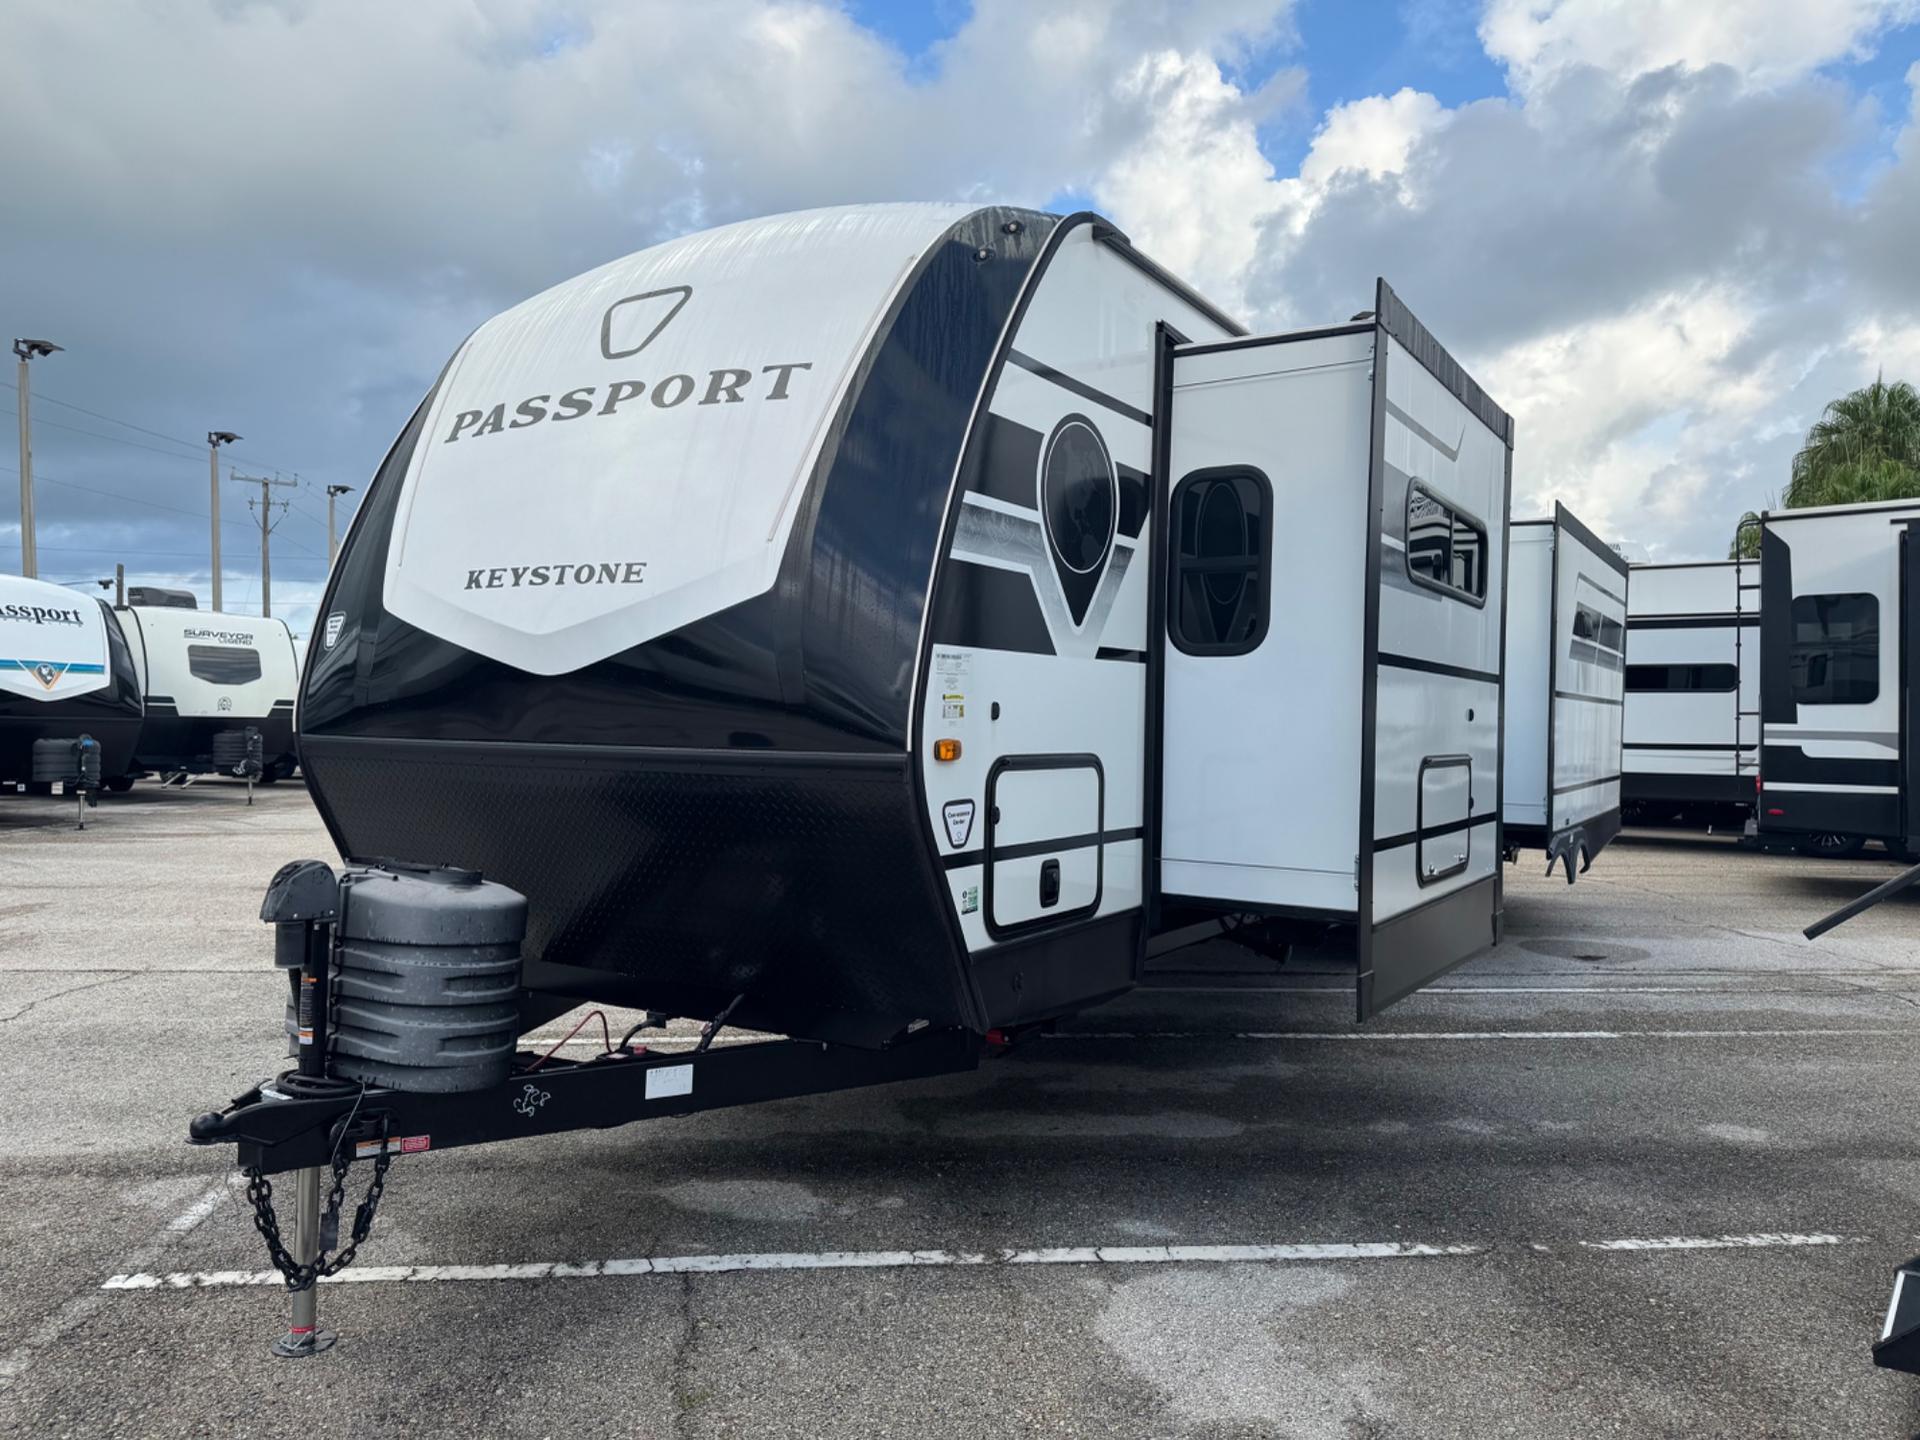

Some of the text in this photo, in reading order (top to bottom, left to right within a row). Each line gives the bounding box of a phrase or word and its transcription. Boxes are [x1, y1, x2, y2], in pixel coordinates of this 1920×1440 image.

[444, 362, 813, 443] PASSPORT
[464, 562, 647, 590] KEYSTONE
[183, 629, 254, 641] SURVEYOR
